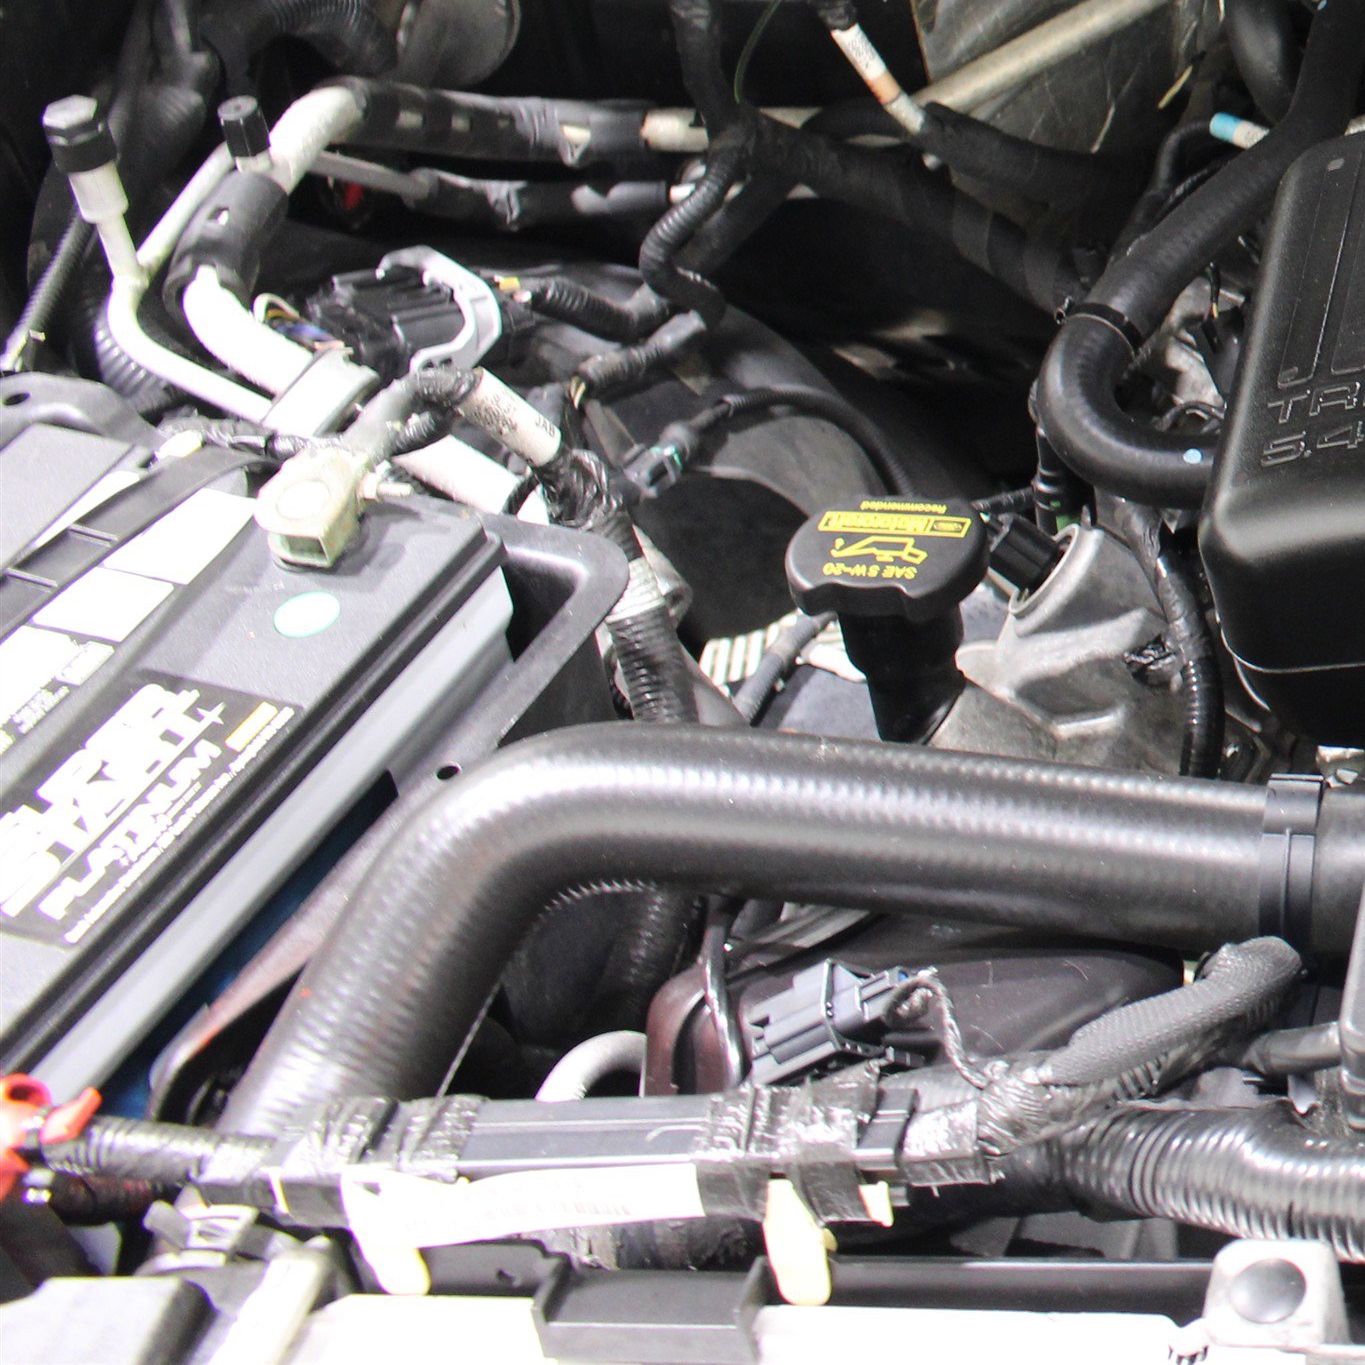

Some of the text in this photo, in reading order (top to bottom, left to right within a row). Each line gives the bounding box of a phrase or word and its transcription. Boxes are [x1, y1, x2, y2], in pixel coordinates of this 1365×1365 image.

[860, 500, 948, 514] Recommended
[828, 512, 929, 534] Motorcraft
[881, 566, 918, 580] SAE
[37, 738, 223, 922] PLATINUM
